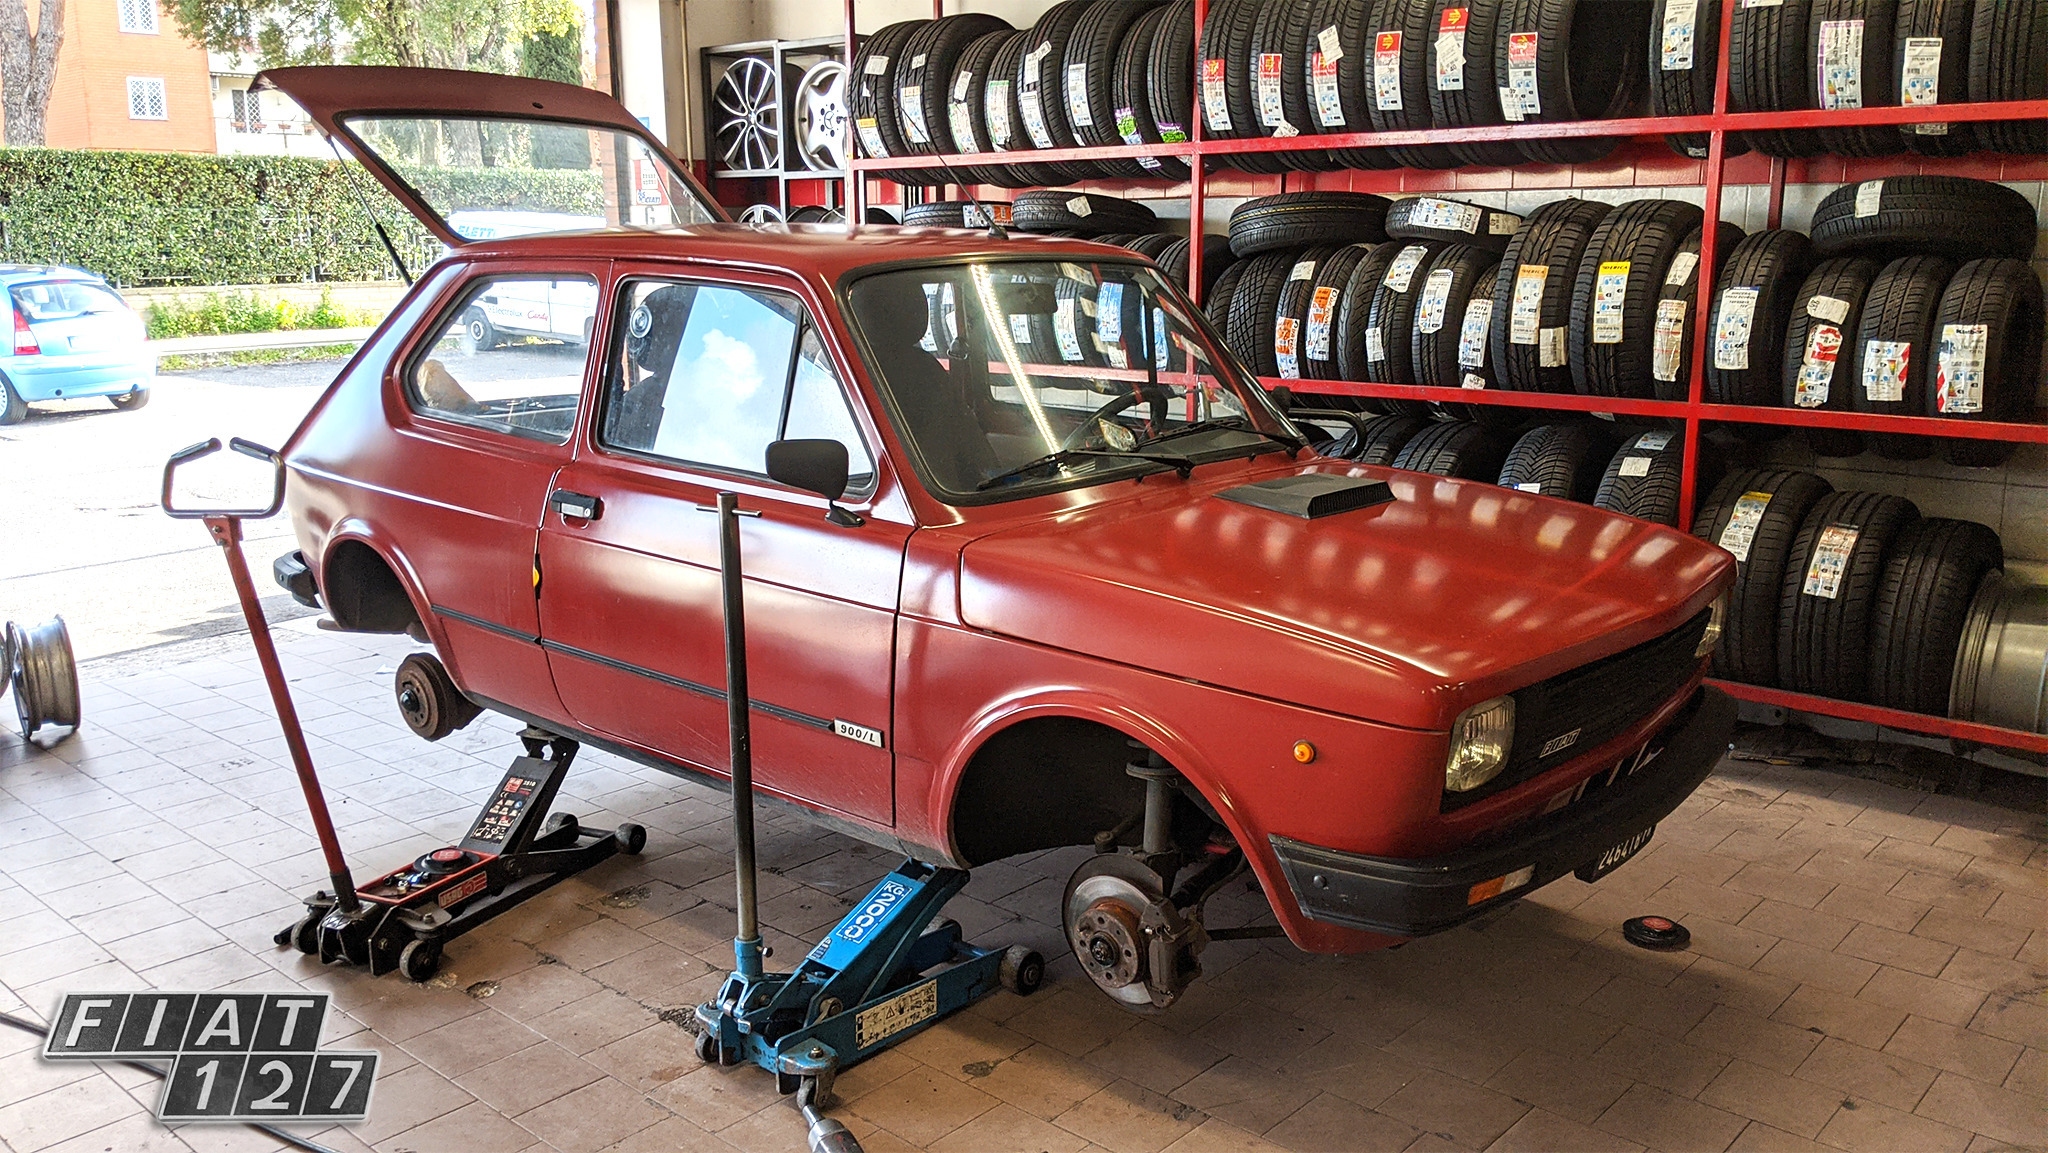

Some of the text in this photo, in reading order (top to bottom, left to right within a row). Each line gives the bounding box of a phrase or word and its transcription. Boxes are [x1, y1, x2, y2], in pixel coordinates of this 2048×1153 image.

[840, 724, 875, 743] 900/L
[1543, 731, 1578, 754] FIAT
[844, 892, 896, 940] 2000
